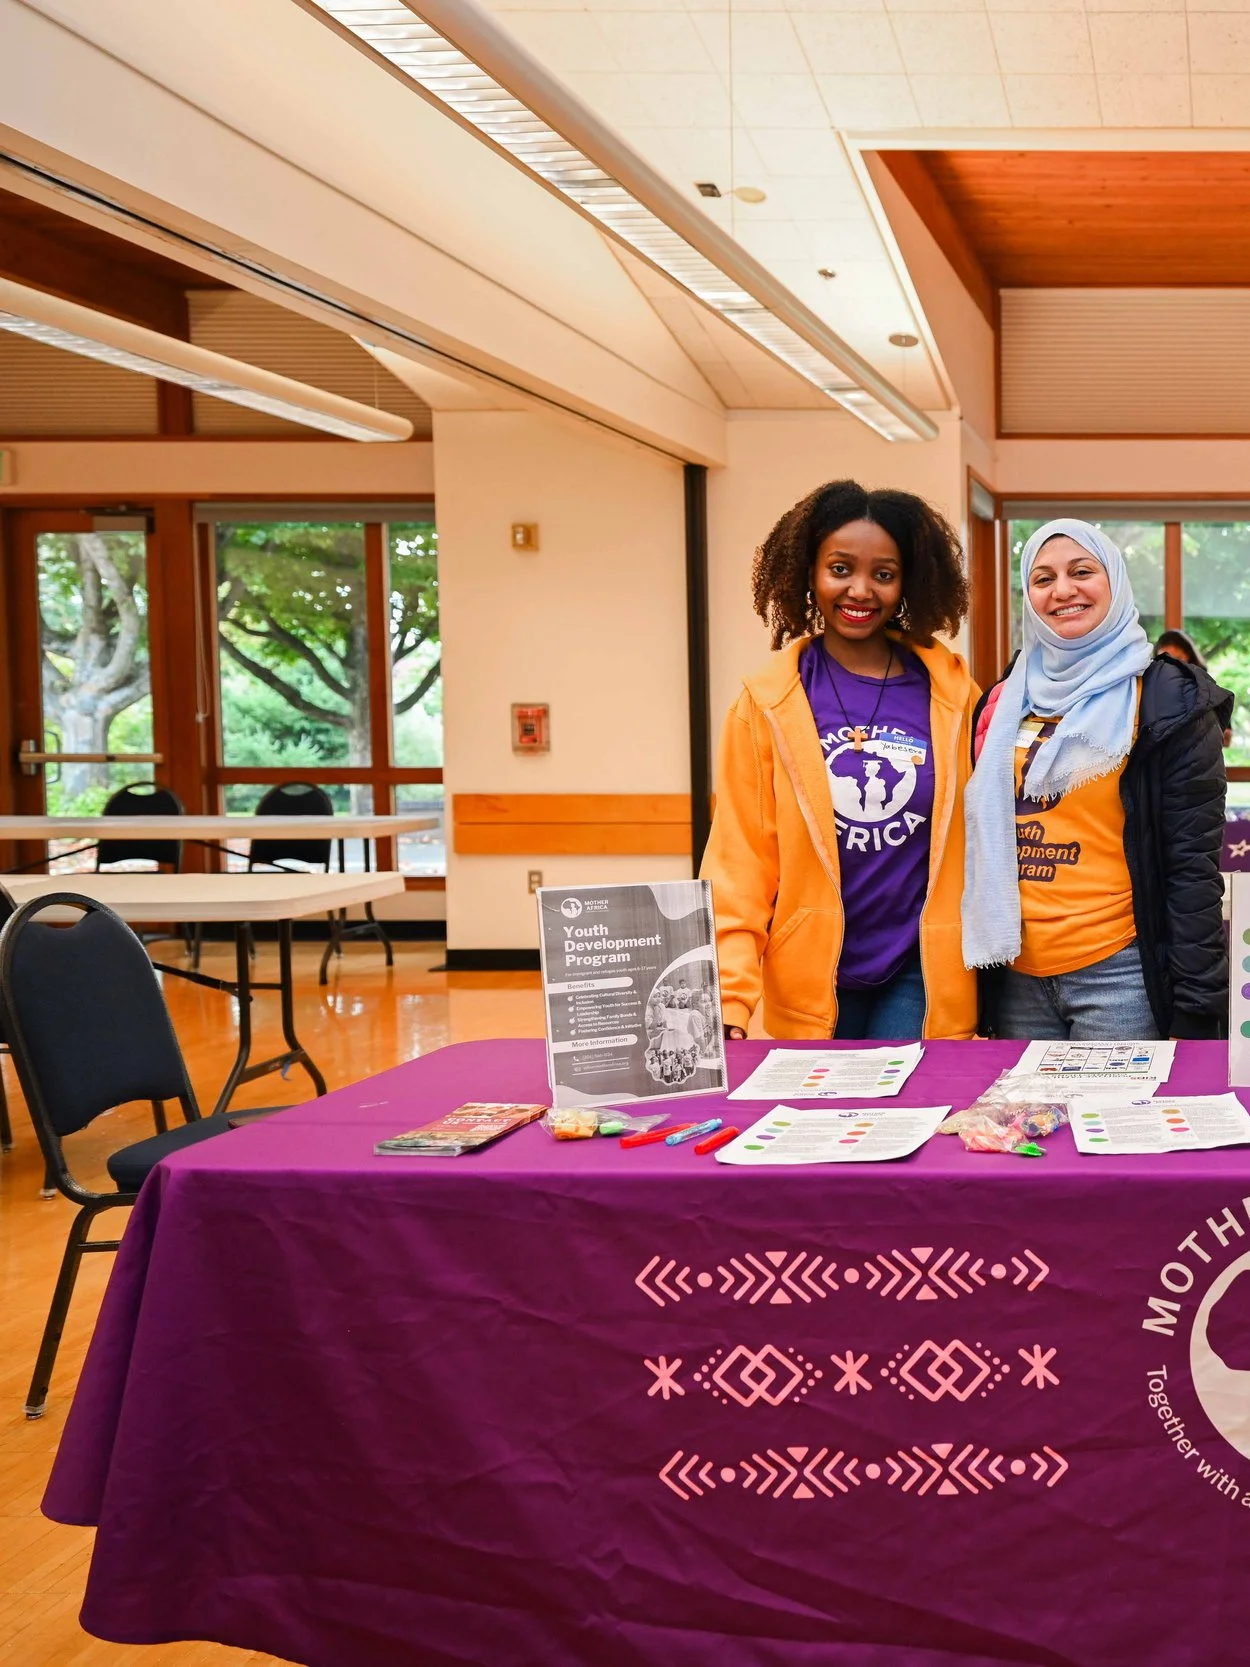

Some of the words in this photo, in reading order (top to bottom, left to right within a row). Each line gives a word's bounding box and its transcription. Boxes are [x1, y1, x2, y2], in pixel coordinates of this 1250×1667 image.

[893, 735, 914, 743] HELLO
[1017, 825, 1041, 841] uth
[563, 924, 609, 938] Youth
[564, 934, 662, 953] Development
[565, 952, 631, 967] Program
[567, 982, 595, 990] Benefits
[589, 1037, 628, 1046] Information
[1146, 1364, 1200, 1460] Together
[1196, 1458, 1241, 1501] with
